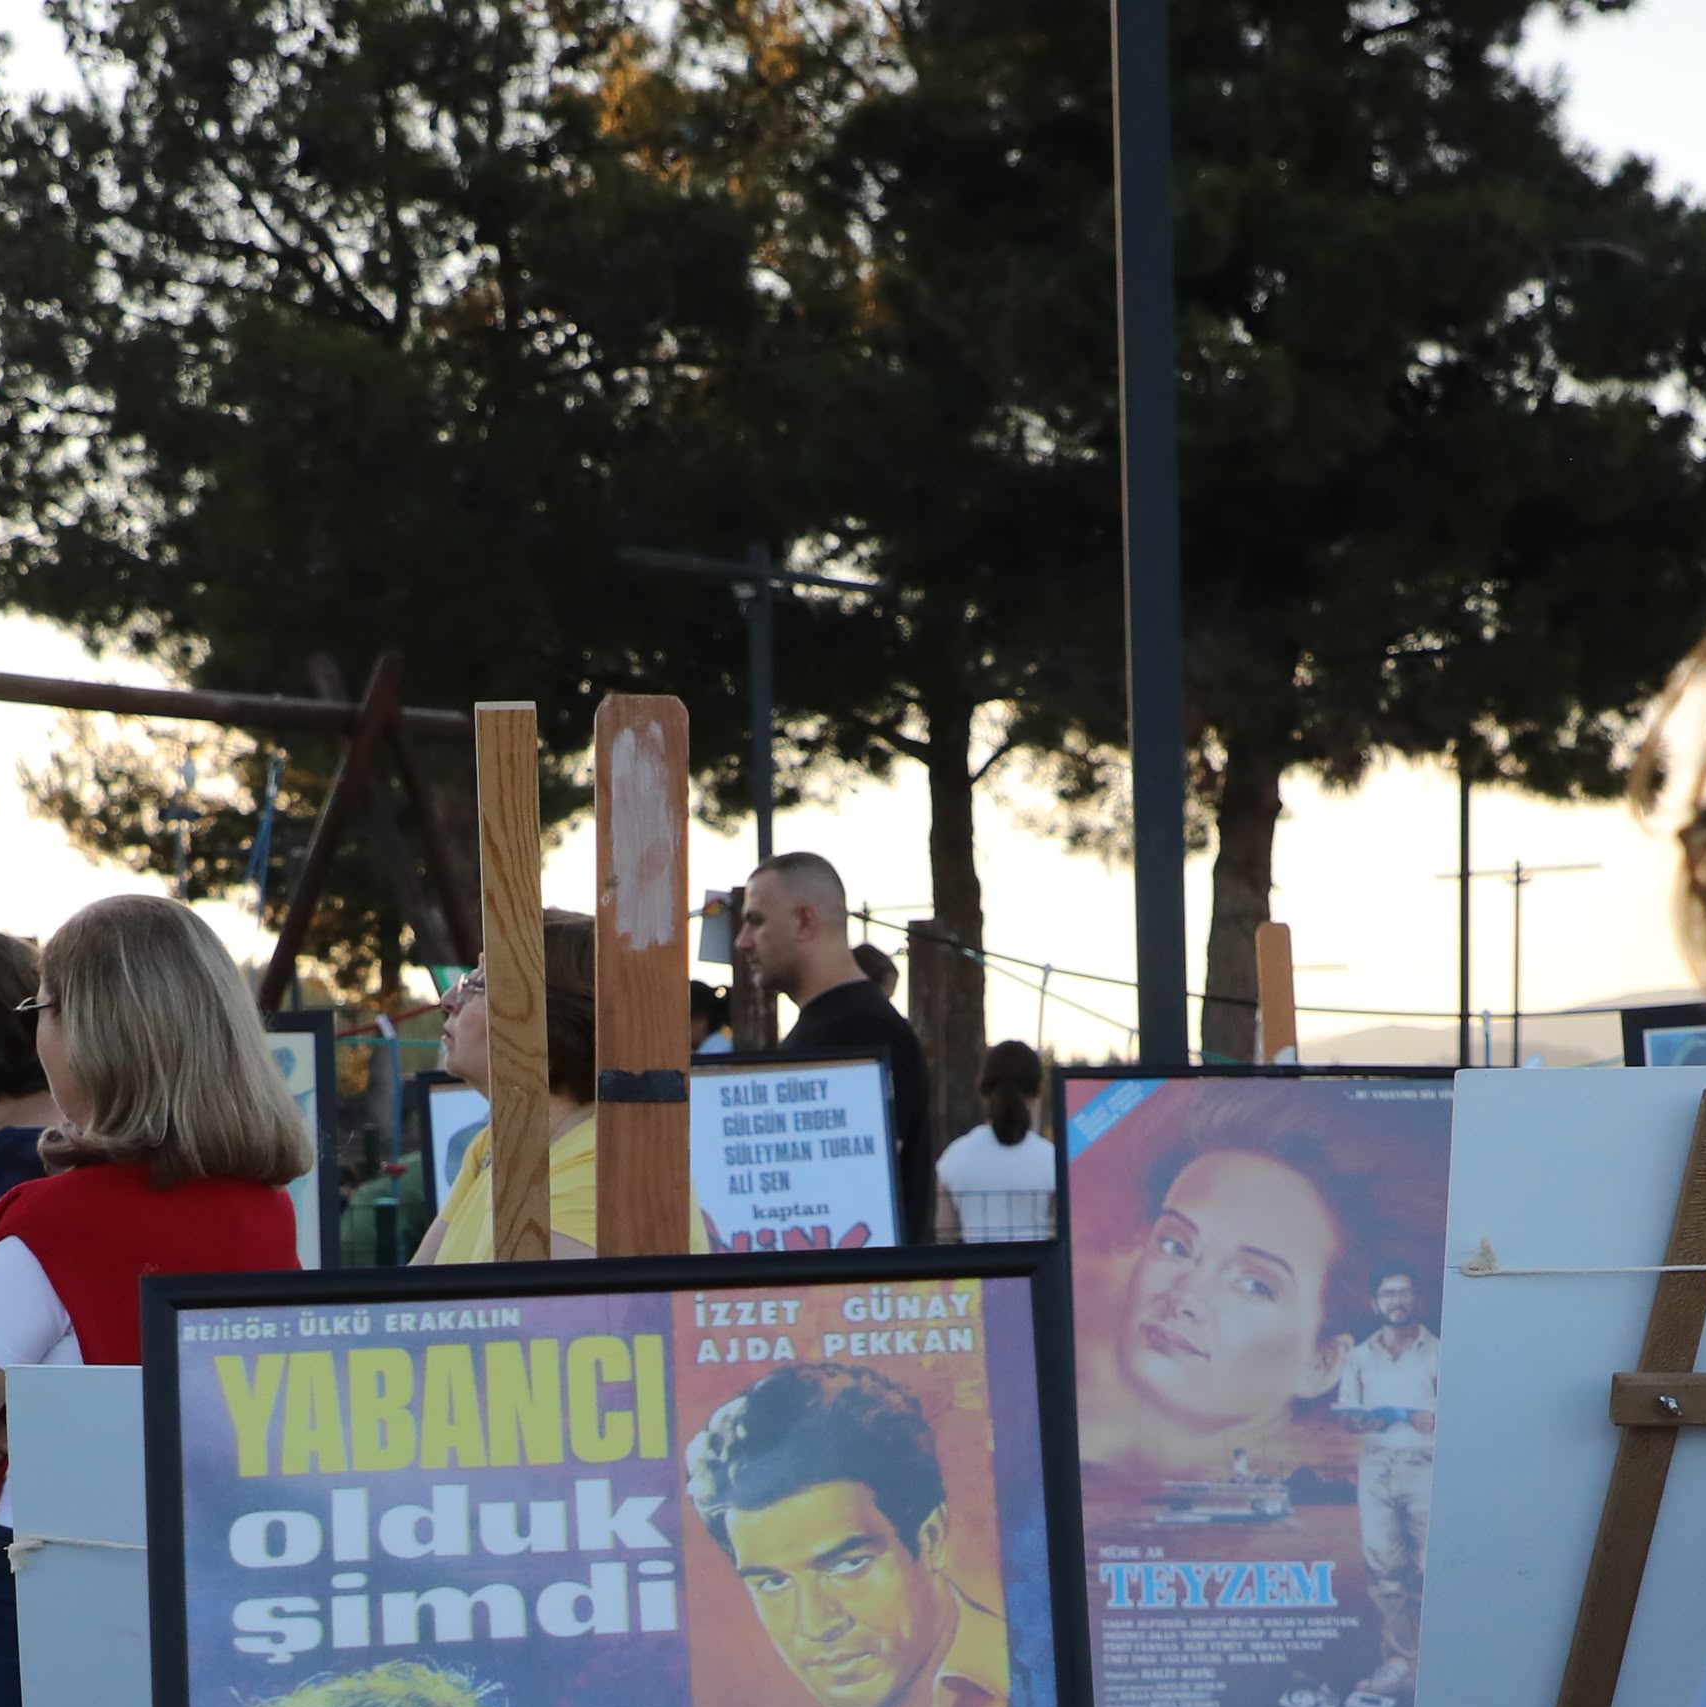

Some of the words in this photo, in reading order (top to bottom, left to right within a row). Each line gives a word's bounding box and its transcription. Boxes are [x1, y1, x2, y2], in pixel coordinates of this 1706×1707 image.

[776, 1077, 829, 1104] GÜNEY
[723, 1108, 787, 1137] GÜLGÜN
[794, 1108, 847, 1132] ERDEM
[724, 1140, 813, 1167] SÜLEYMAN
[820, 1134, 876, 1160] TURAN
[728, 1168, 754, 1195] ALİ
[759, 1170, 790, 1195] ŞEN
[752, 1202, 830, 1222] kaptan
[299, 1309, 372, 1338] ÜLKÜ
[385, 1307, 522, 1335] ERAKALIN
[694, 1291, 803, 1330] İZZET
[843, 1284, 973, 1324] GÜNAY
[696, 1335, 798, 1366] AJDA
[824, 1325, 976, 1359] PEKKAN
[215, 1333, 670, 1479] YABANCI
[228, 1479, 672, 1571] olduk
[1099, 1561, 1339, 1610] TEYZEM
[231, 1561, 679, 1665] şimdi
